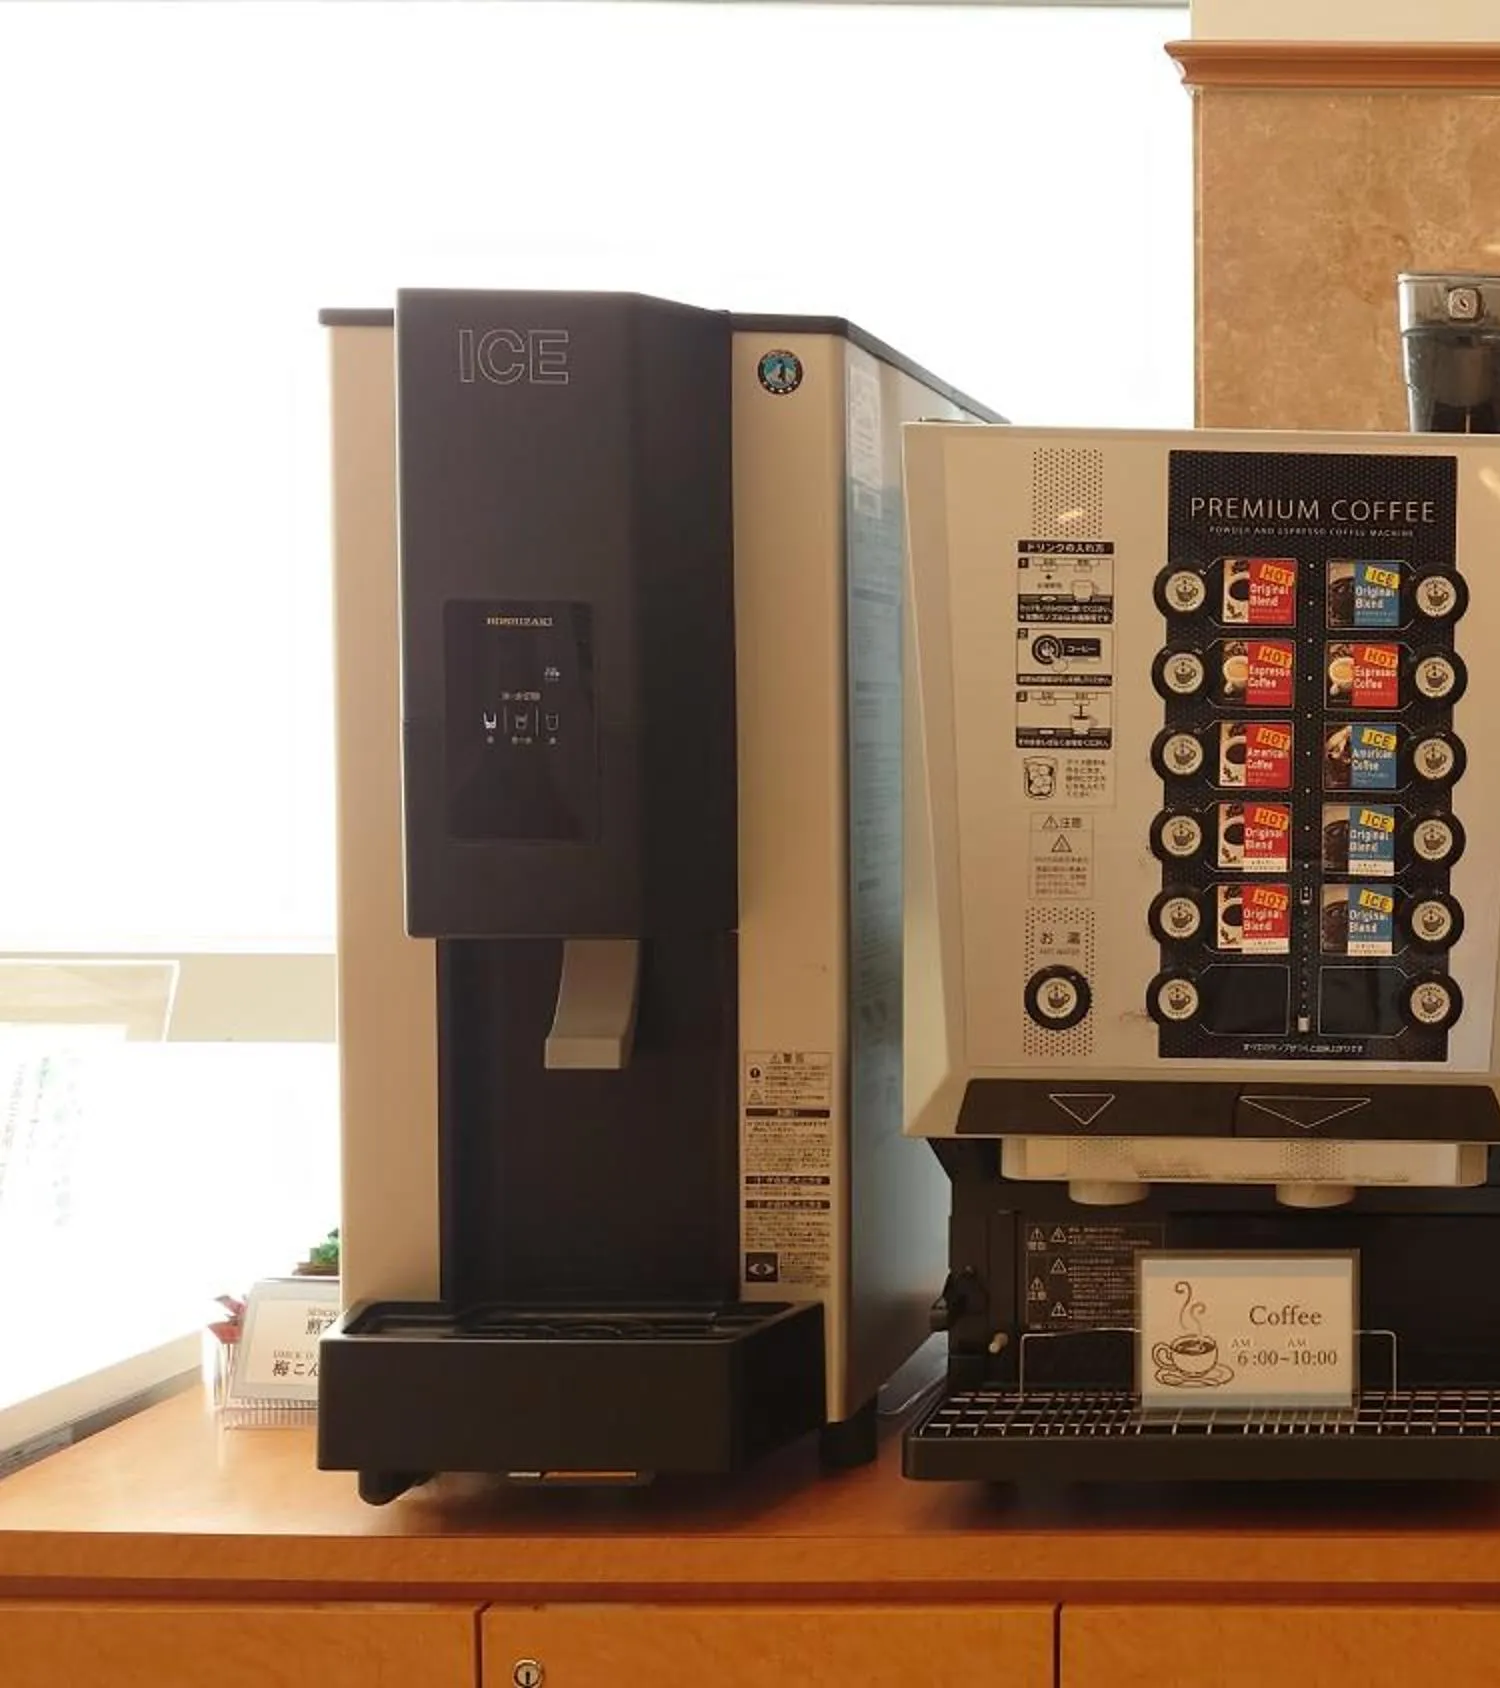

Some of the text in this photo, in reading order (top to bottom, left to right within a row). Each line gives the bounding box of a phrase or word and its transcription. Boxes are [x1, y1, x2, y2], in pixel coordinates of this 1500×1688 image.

[459, 329, 569, 385] ICE
[1190, 497, 1437, 523] PREMIUM COFFEE
[1254, 526, 1274, 535] AND
[1026, 543, 1106, 553] ドリンクの入れ方
[1262, 564, 1293, 584] HOT
[1368, 566, 1396, 587] ICE
[1250, 583, 1290, 597] Original
[1355, 586, 1395, 600] Original
[1250, 597, 1279, 607] Blend
[1355, 599, 1384, 609] Blend
[1067, 644, 1097, 653] コーヒー
[1261, 647, 1291, 667] HOT
[1366, 648, 1397, 667] HOT
[1249, 666, 1291, 679] Espresso
[1355, 667, 1396, 679] Espresso
[1248, 677, 1277, 688] Coffee
[1354, 679, 1383, 689] Coffee
[1259, 729, 1289, 749] HOT
[1366, 731, 1393, 749] ICE
[1246, 747, 1288, 760] American
[1351, 748, 1393, 760] American
[1246, 759, 1274, 770] Coffee
[1351, 760, 1379, 772] Coffee
[1257, 809, 1287, 828] HOT
[1364, 811, 1391, 830] ICE
[1245, 828, 1284, 841] Original
[1350, 829, 1389, 843] Original
[1245, 840, 1273, 851] Blend
[1350, 842, 1378, 853] Blend
[1256, 890, 1286, 909] HOT
[1364, 891, 1391, 910] ICE
[1243, 909, 1282, 923] Original
[1349, 910, 1388, 924] Original
[1243, 920, 1272, 931] Blend
[1349, 923, 1377, 933] Blend
[1249, 1305, 1322, 1326] Coffee
[1231, 1338, 1307, 1349] AM AM
